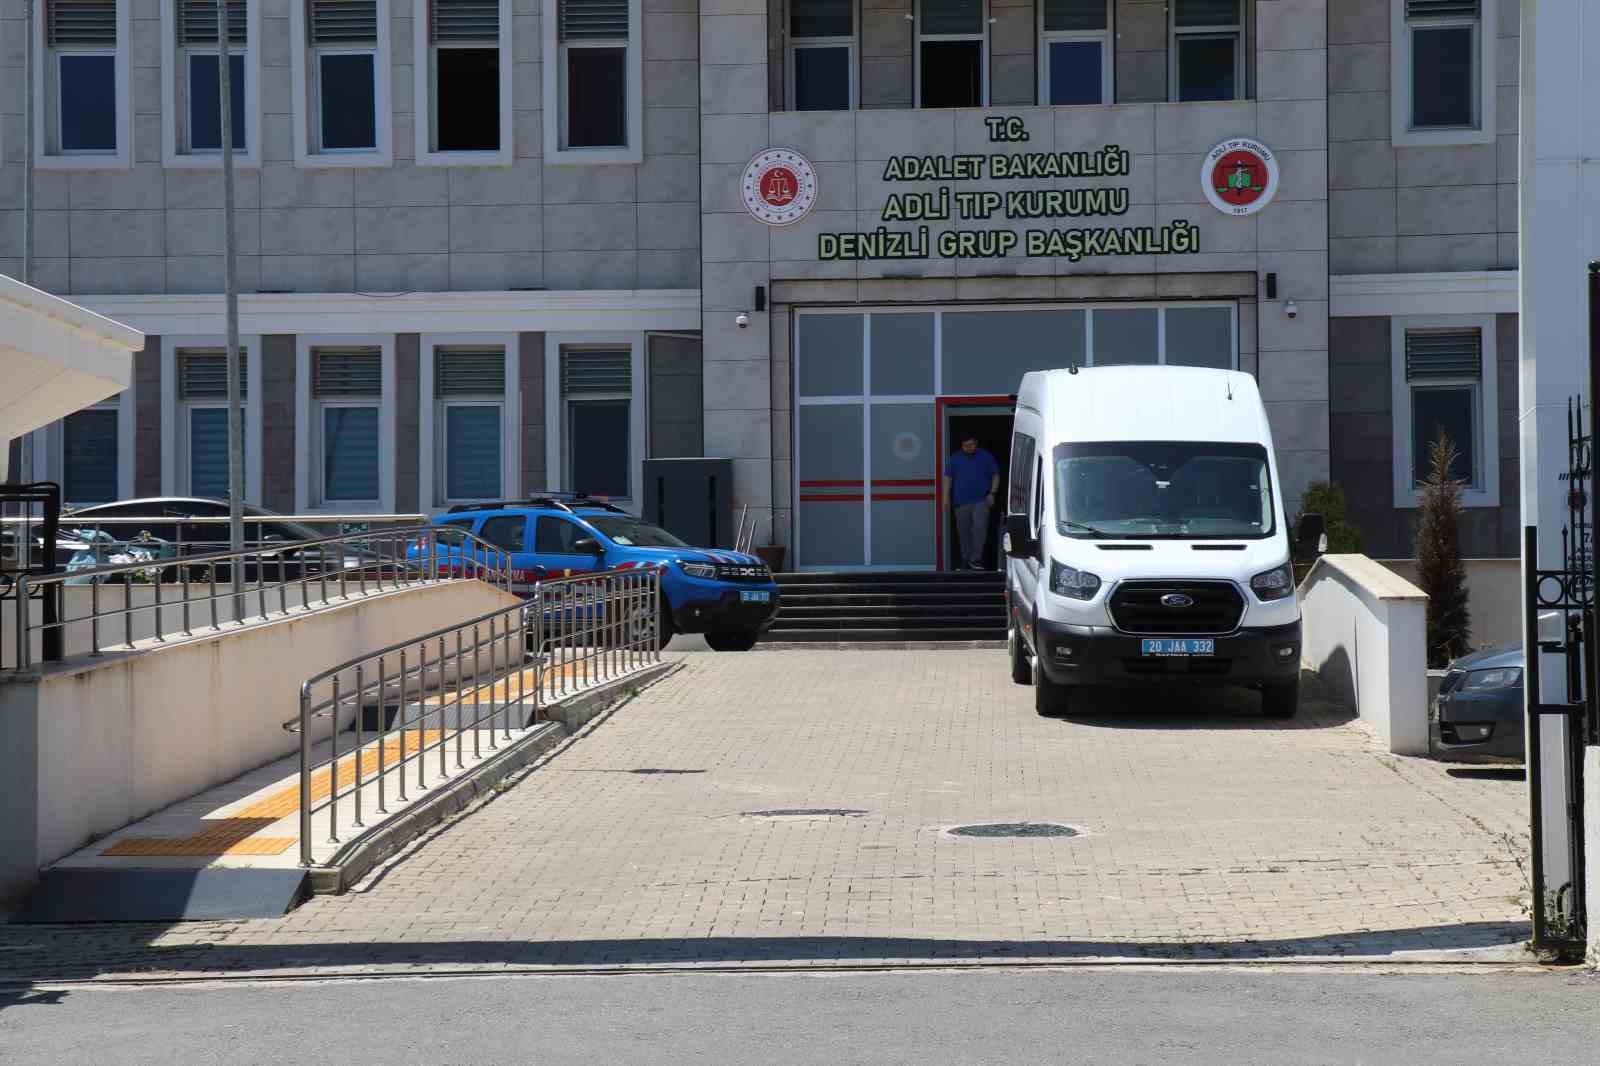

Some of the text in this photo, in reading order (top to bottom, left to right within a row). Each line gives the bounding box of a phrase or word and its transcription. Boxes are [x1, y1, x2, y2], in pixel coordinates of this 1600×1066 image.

[986, 117, 1029, 140] T.C.
[884, 145, 1129, 180] ADALET BAKANLIĞI
[882, 188, 1129, 220] ADLİ TIP KURUMU
[818, 220, 1200, 262] DENİZLİ GRUP BAŞKANLIĞI
[1149, 640, 1212, 652] 20 JAA 332
